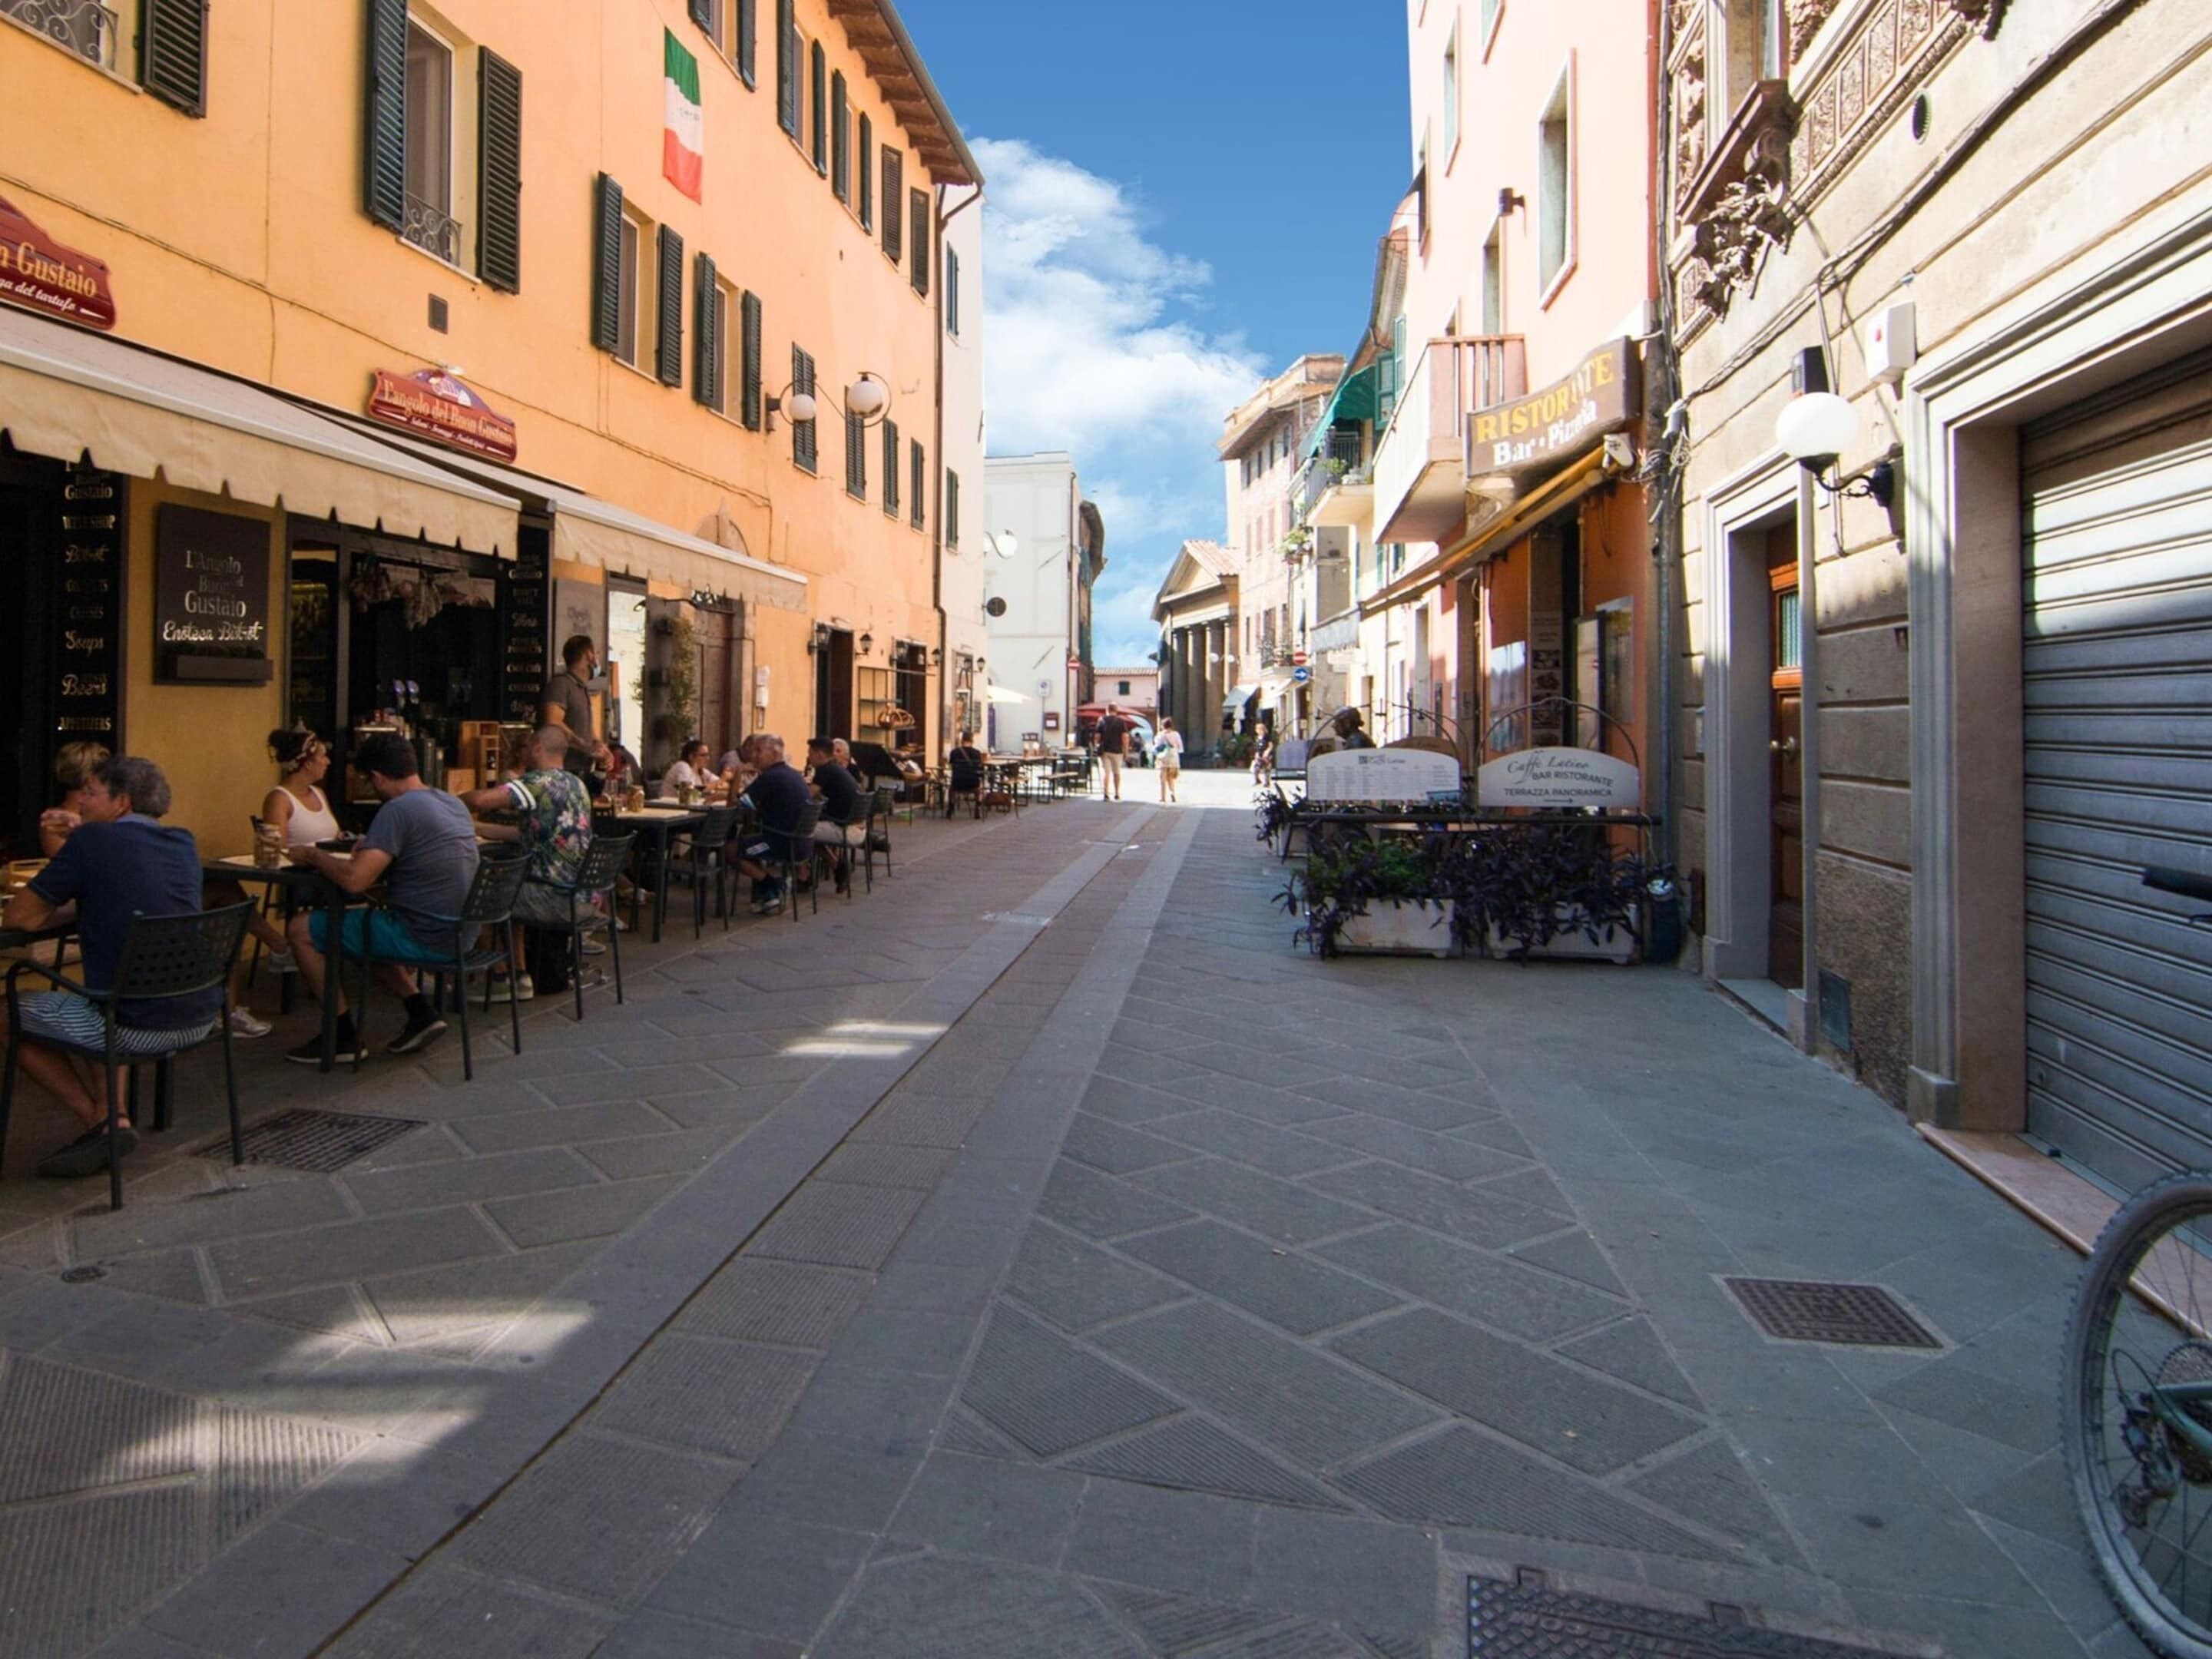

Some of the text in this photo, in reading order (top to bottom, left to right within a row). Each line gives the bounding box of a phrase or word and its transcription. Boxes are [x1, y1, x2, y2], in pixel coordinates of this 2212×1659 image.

[17, 241, 98, 297] Gustaio
[15, 282, 37, 297] del
[35, 289, 77, 311] tartufo
[432, 399, 448, 423] del
[449, 406, 477, 434] Buon
[1493, 438, 1535, 467] Bar
[184, 589, 247, 618] Gustaio
[65, 630, 104, 657] Soups
[162, 620, 215, 642] Enoteca
[61, 673, 108, 696] Beers
[1503, 787, 1612, 796] TERRAZZA PANORAMICA
[1532, 771, 1614, 787] BAR RISTORANTE
